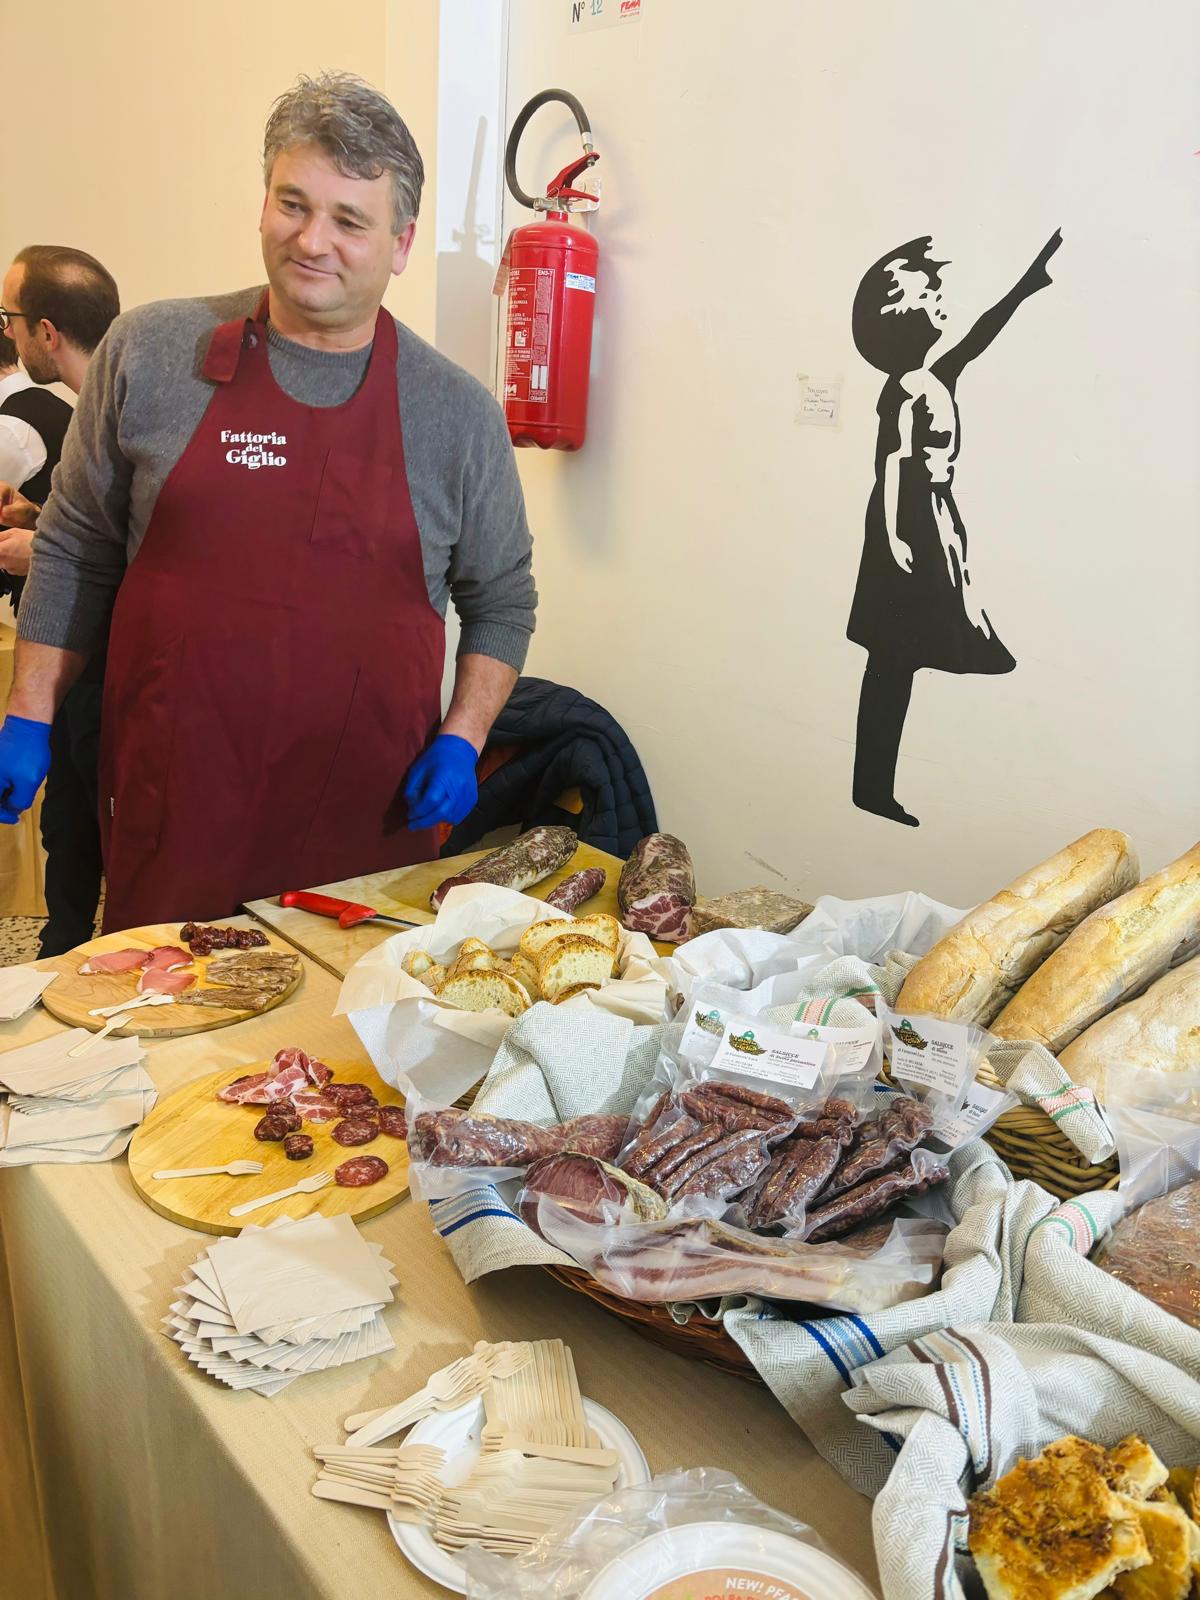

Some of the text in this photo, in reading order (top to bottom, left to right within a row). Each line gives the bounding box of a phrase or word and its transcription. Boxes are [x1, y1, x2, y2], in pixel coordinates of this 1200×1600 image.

[220, 430, 287, 445] Fattoria
[245, 443, 263, 452] del
[225, 449, 287, 470] Giglio
[725, 1577, 764, 1593] NEW!
